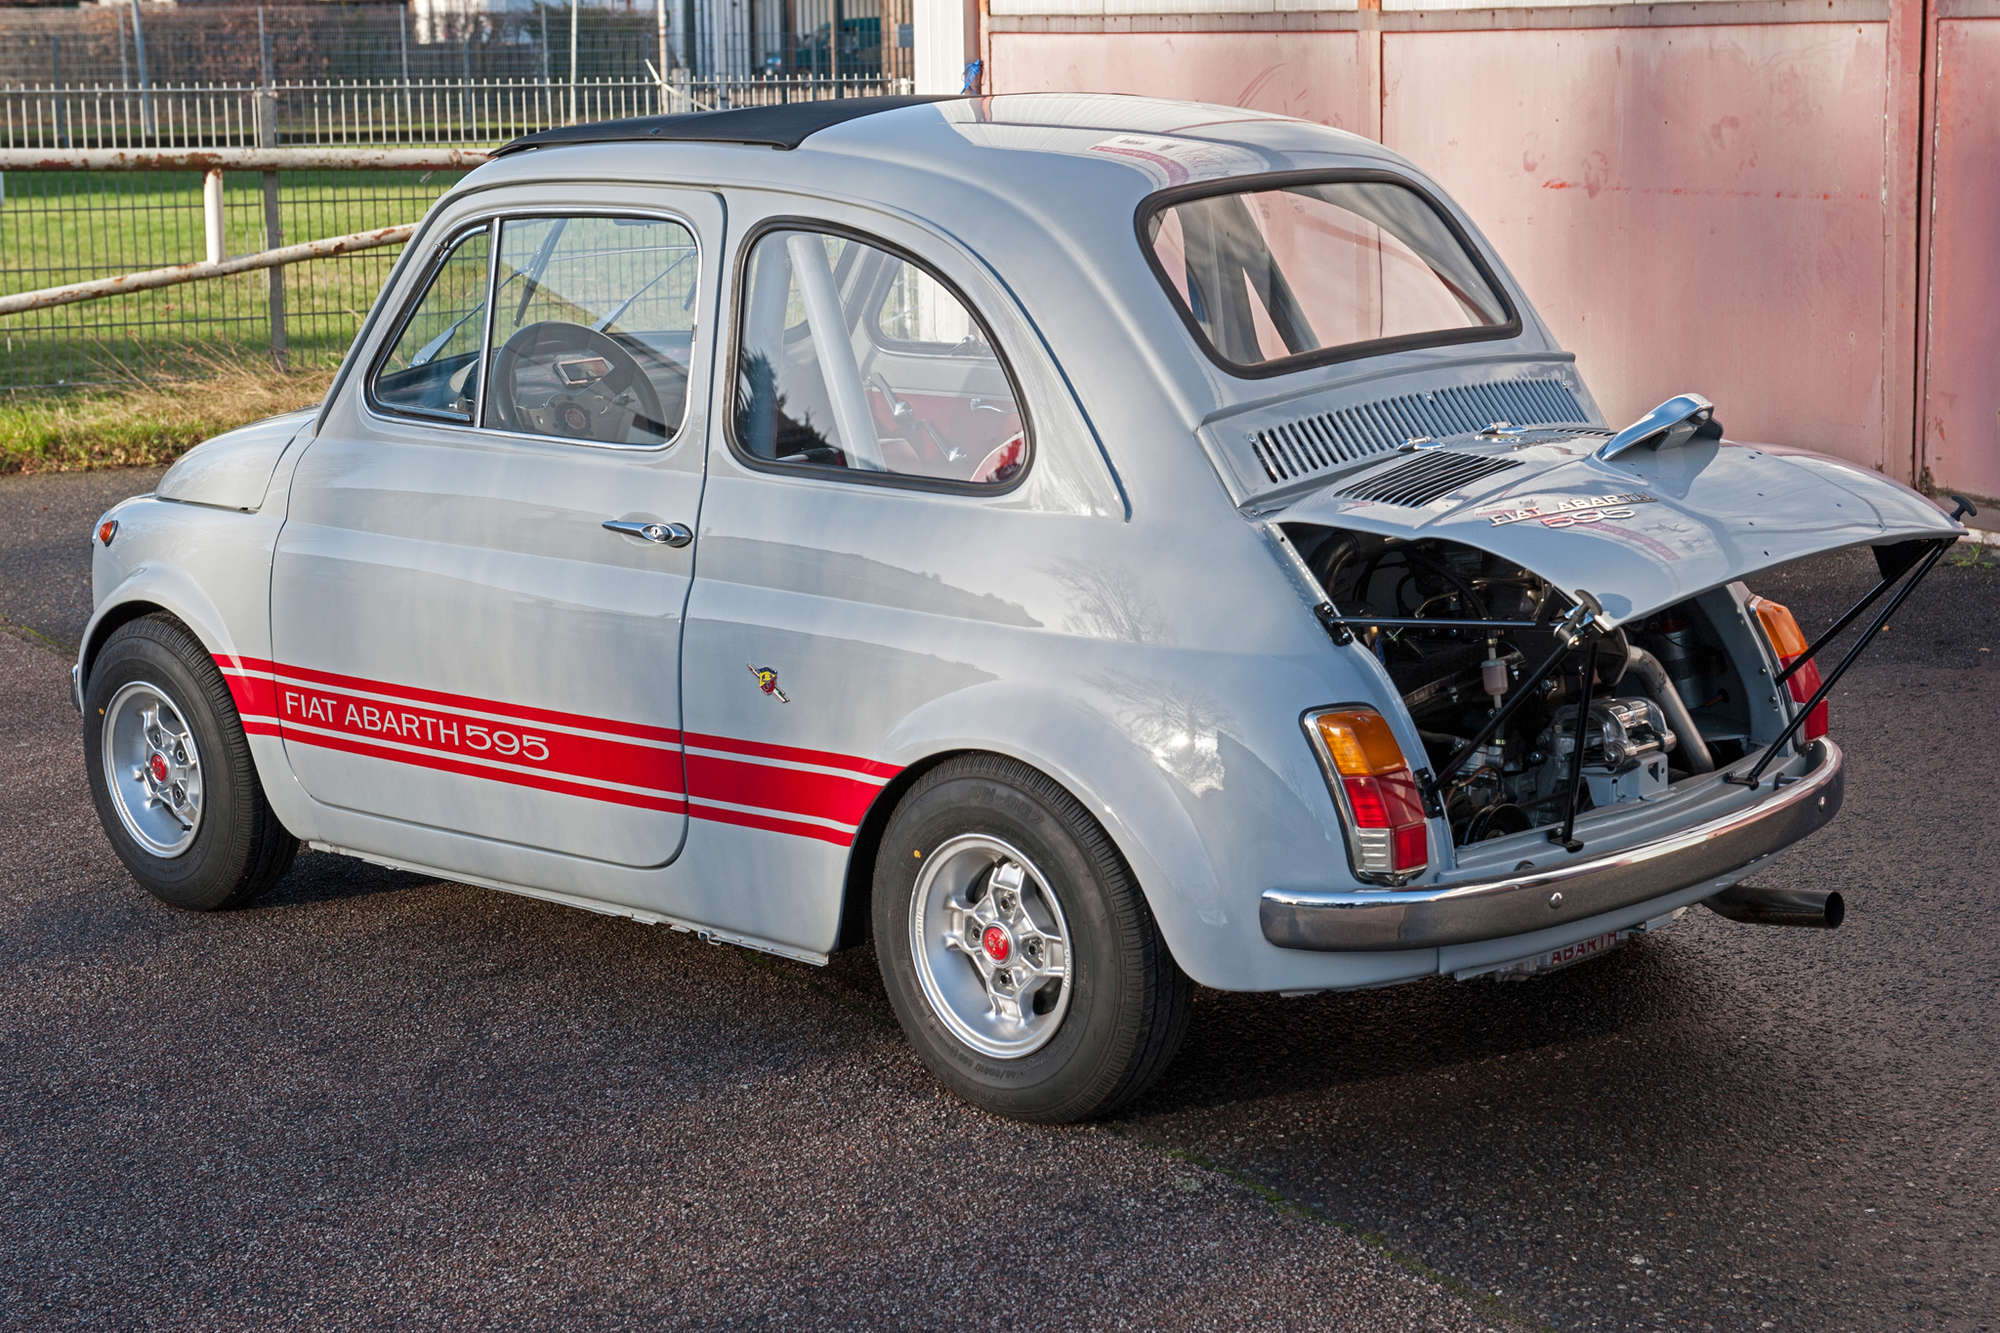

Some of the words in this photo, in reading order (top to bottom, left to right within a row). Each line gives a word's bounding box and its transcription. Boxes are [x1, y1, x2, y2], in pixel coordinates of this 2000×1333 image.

[1490, 506, 1541, 525] FIAT
[1557, 491, 1654, 511] ABARTH
[1541, 506, 1636, 528] 595
[285, 691, 337, 722] FIAT
[345, 704, 460, 745] ABARTH
[465, 724, 550, 761] 595
